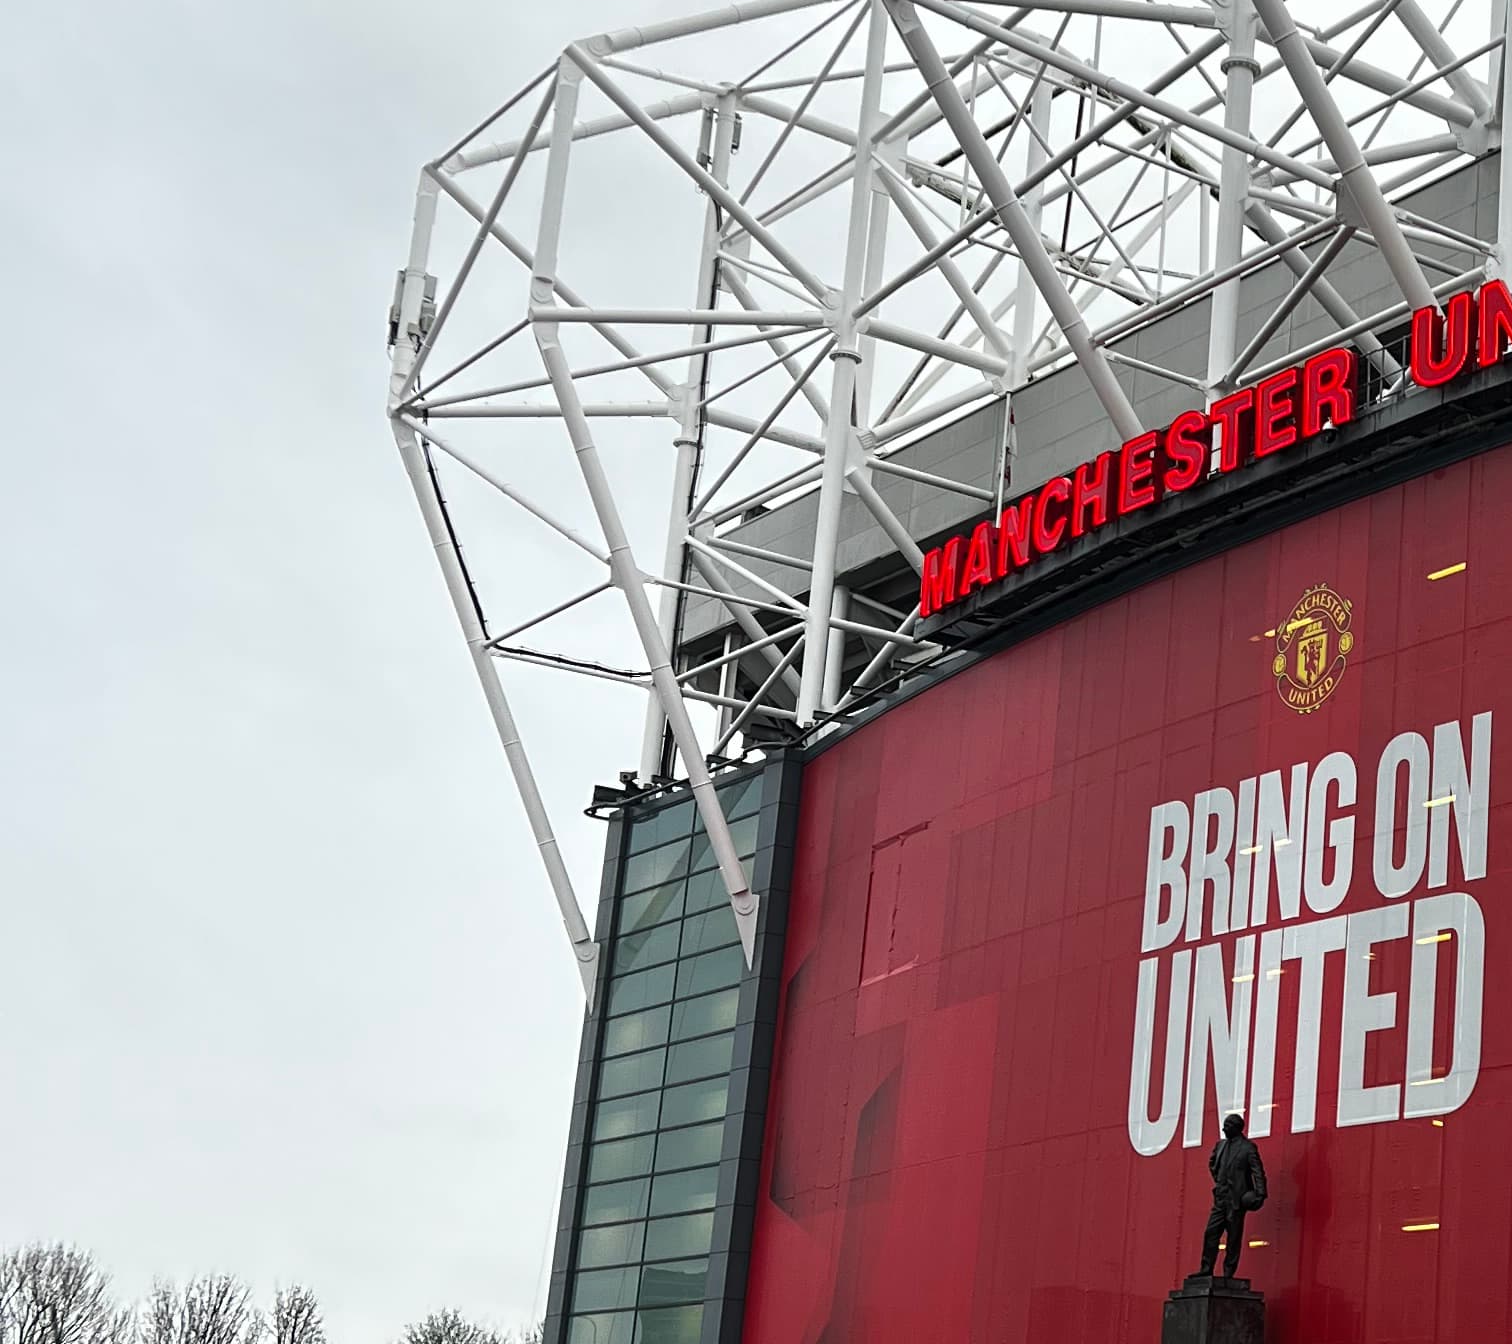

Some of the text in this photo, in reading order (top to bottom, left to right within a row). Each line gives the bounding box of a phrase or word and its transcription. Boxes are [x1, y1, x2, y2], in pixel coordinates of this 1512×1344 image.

[919, 346, 1361, 619] MANCHESTER
[1288, 676, 1334, 706] UNITED
[1141, 710, 1493, 954] BRING ON
[1127, 891, 1486, 1157] UNITED
